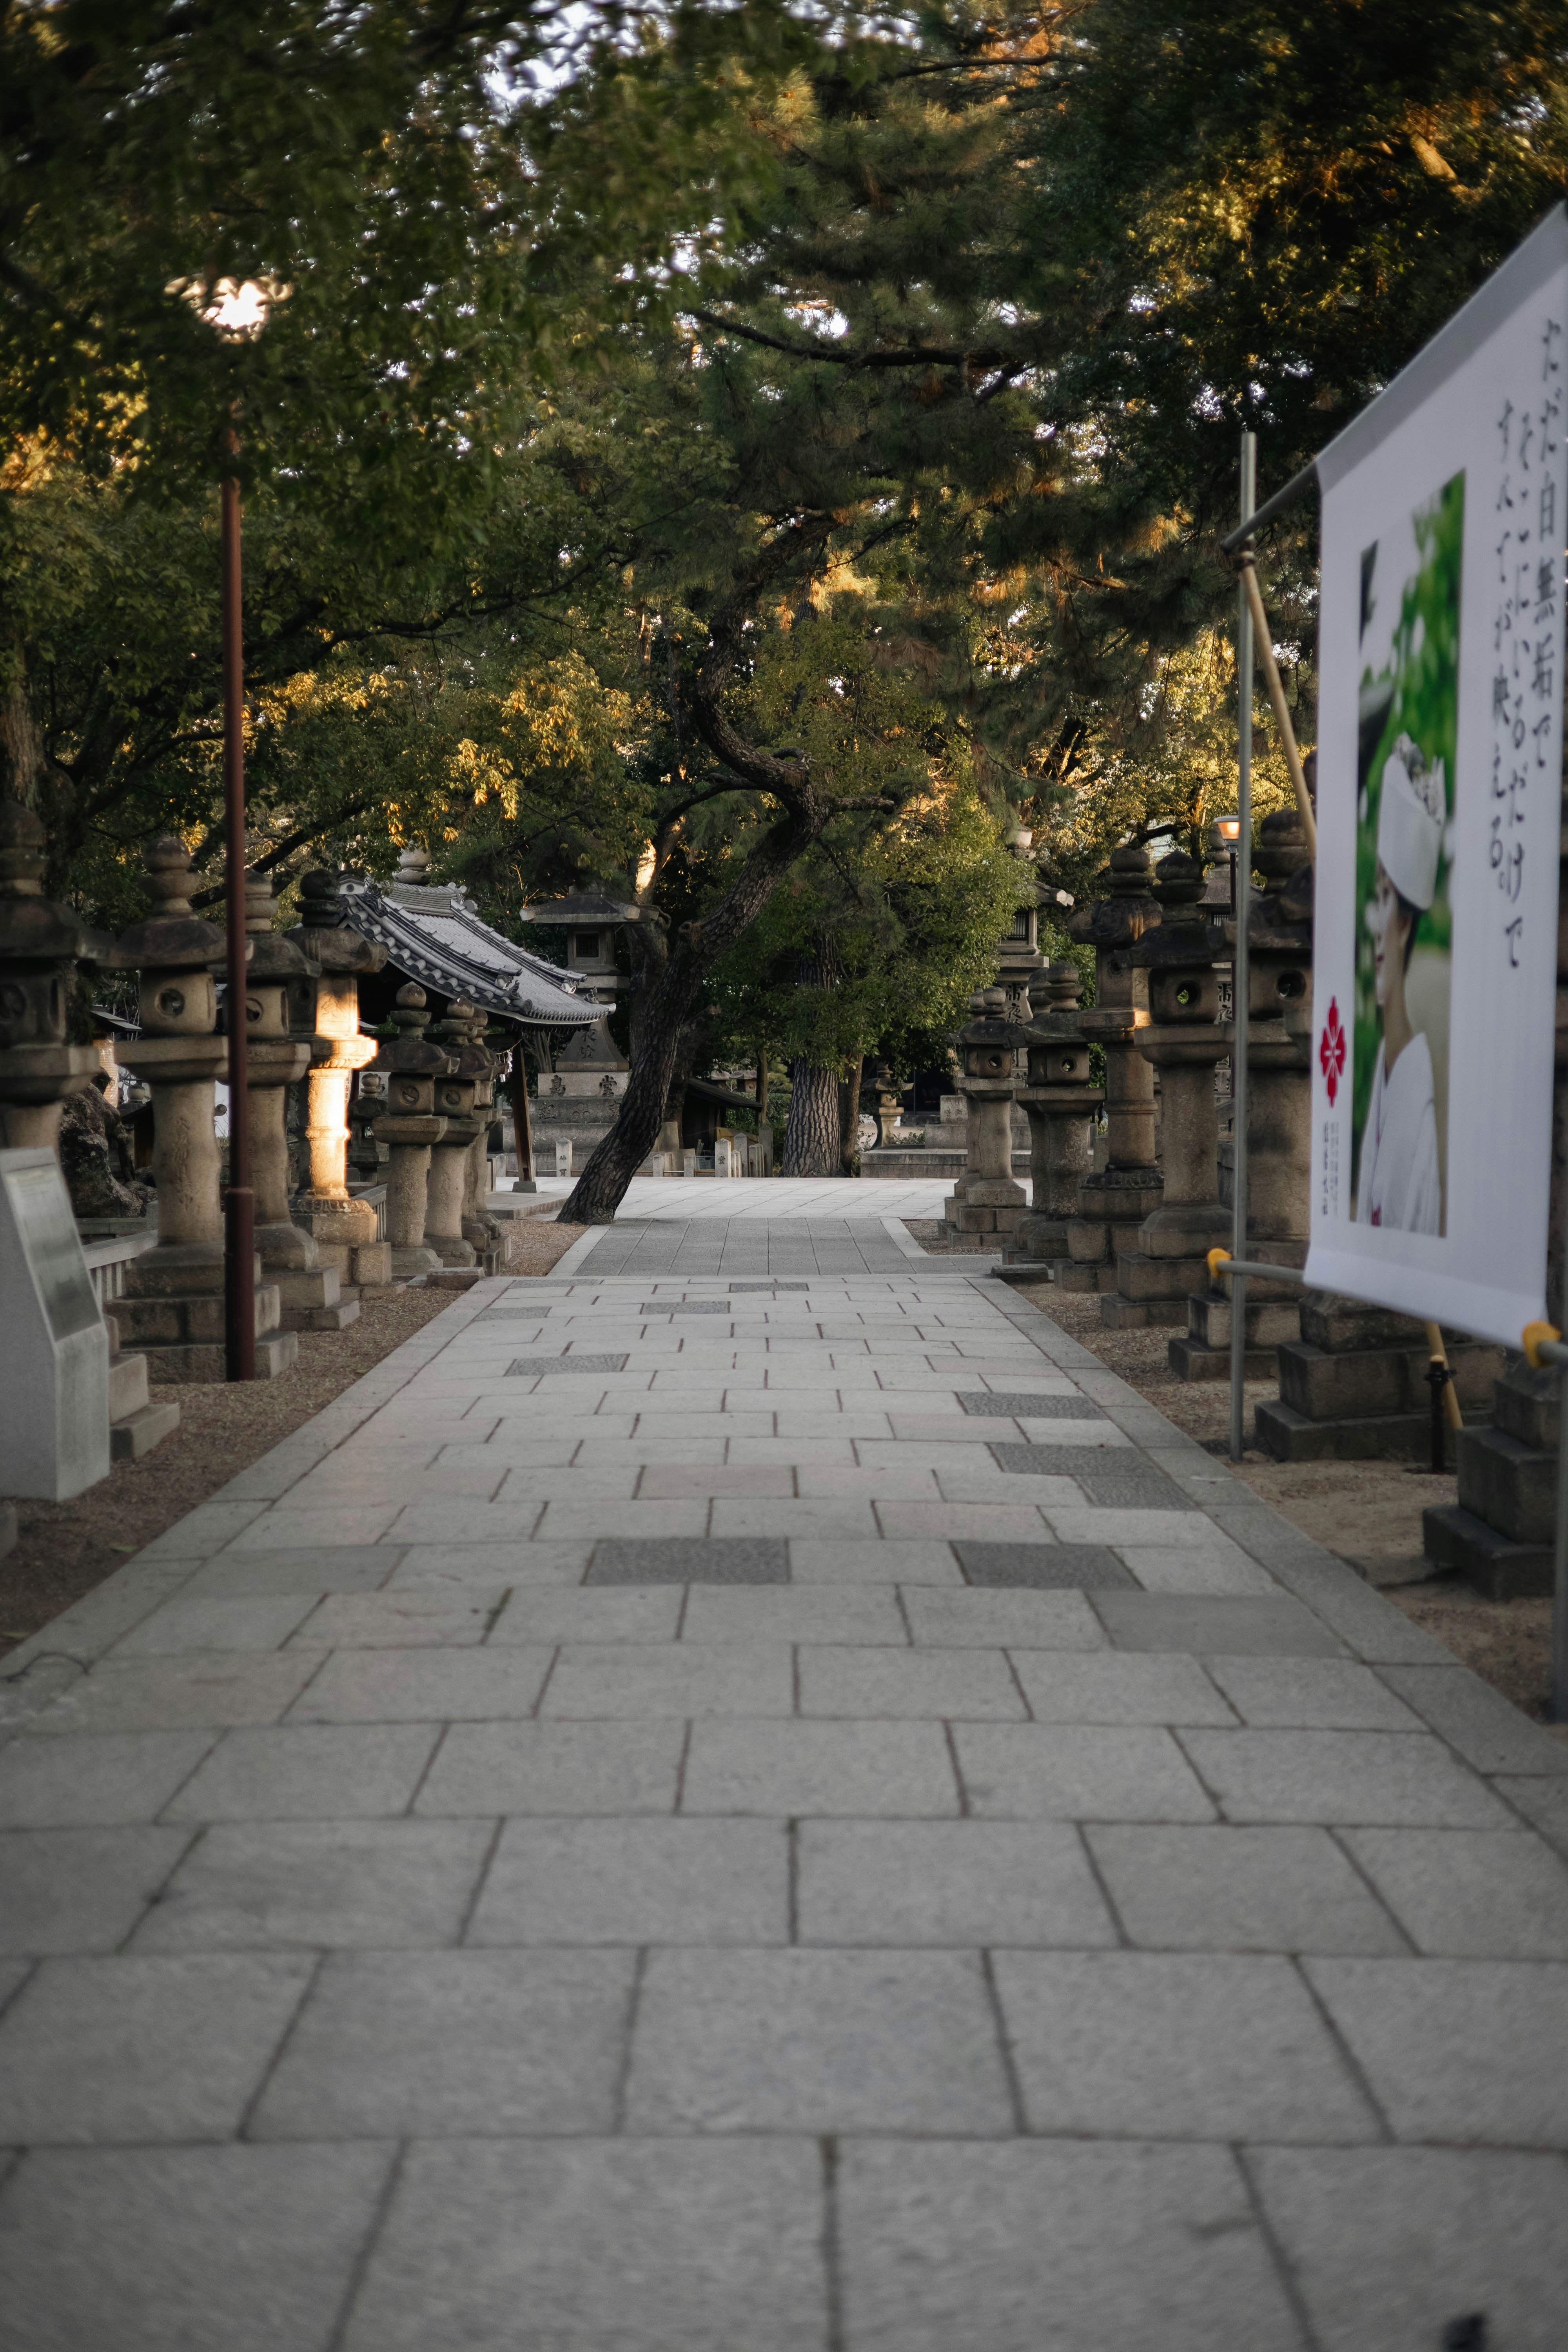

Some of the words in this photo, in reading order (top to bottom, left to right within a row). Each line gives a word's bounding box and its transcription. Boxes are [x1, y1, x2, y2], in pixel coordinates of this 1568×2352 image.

[1490, 399, 1514, 890] すべてが映える。
[1505, 412, 1533, 967] そこにいるだけで
[1531, 318, 1562, 769] ただ白無垢で
